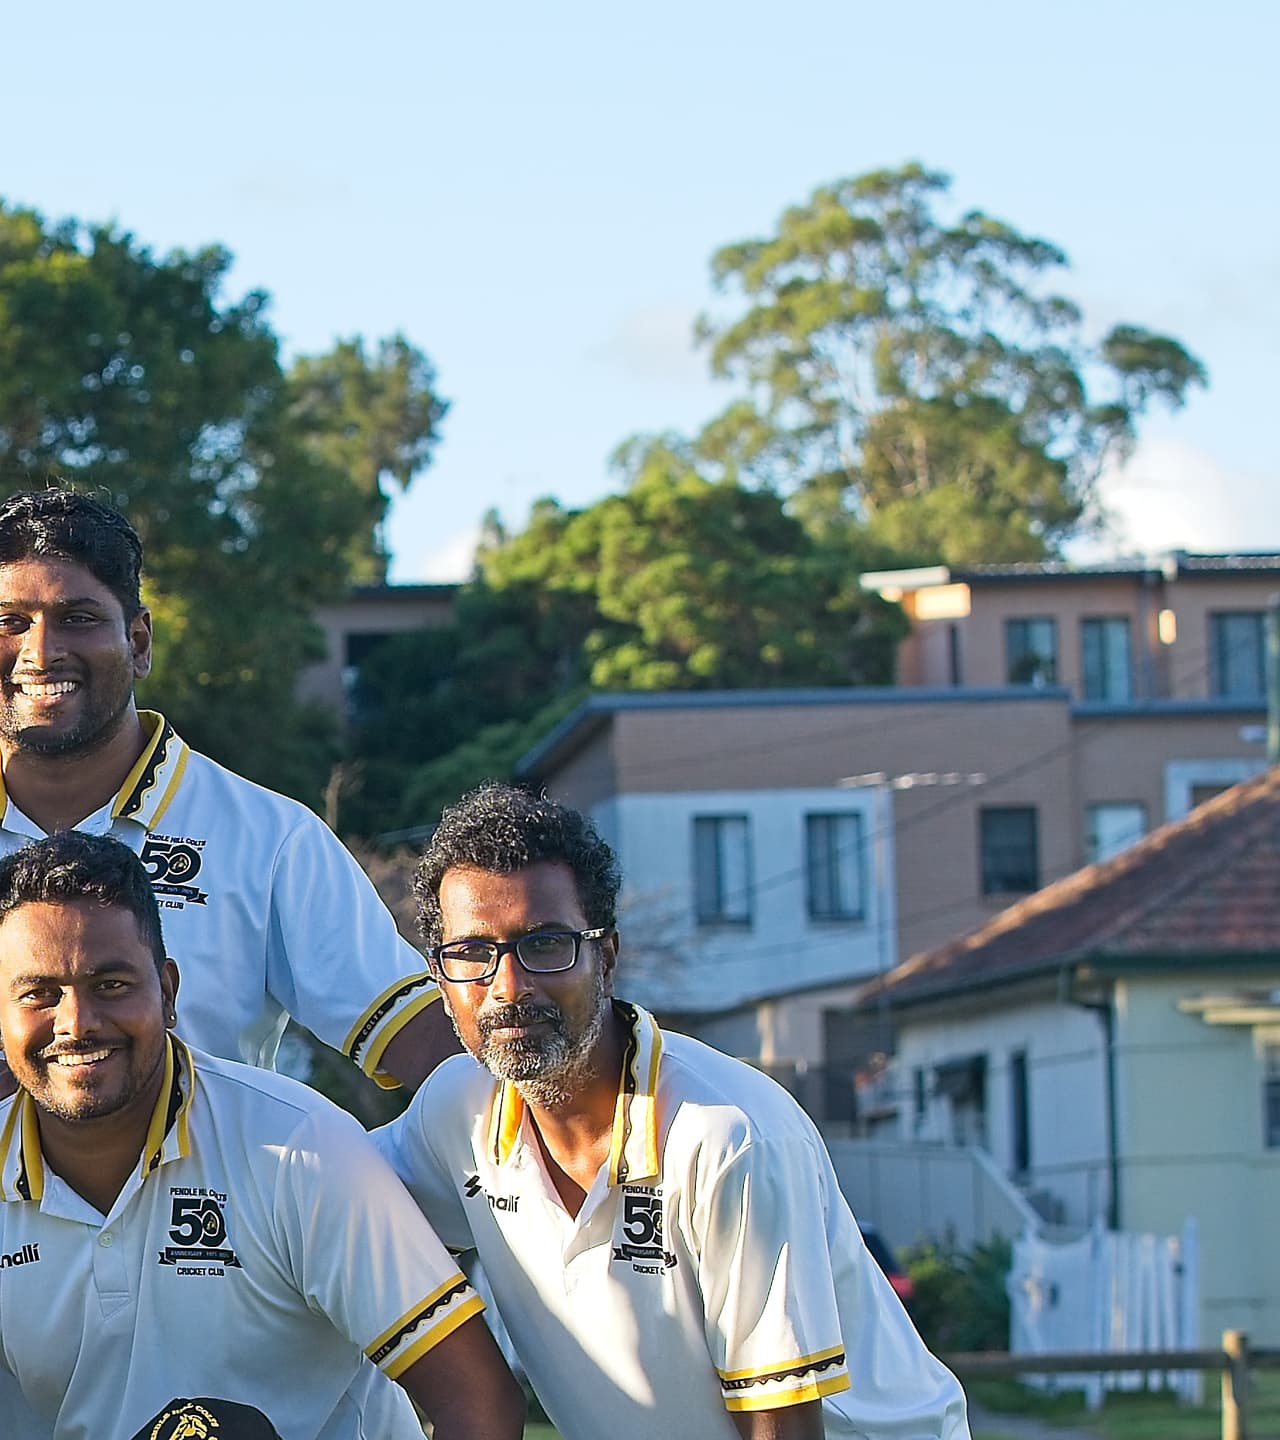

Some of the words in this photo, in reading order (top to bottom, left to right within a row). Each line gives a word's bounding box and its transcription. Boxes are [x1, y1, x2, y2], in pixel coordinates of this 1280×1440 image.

[168, 1198, 228, 1248] 50
[1, 1243, 40, 1269] nalli
[176, 1267, 207, 1276] CRICKET
